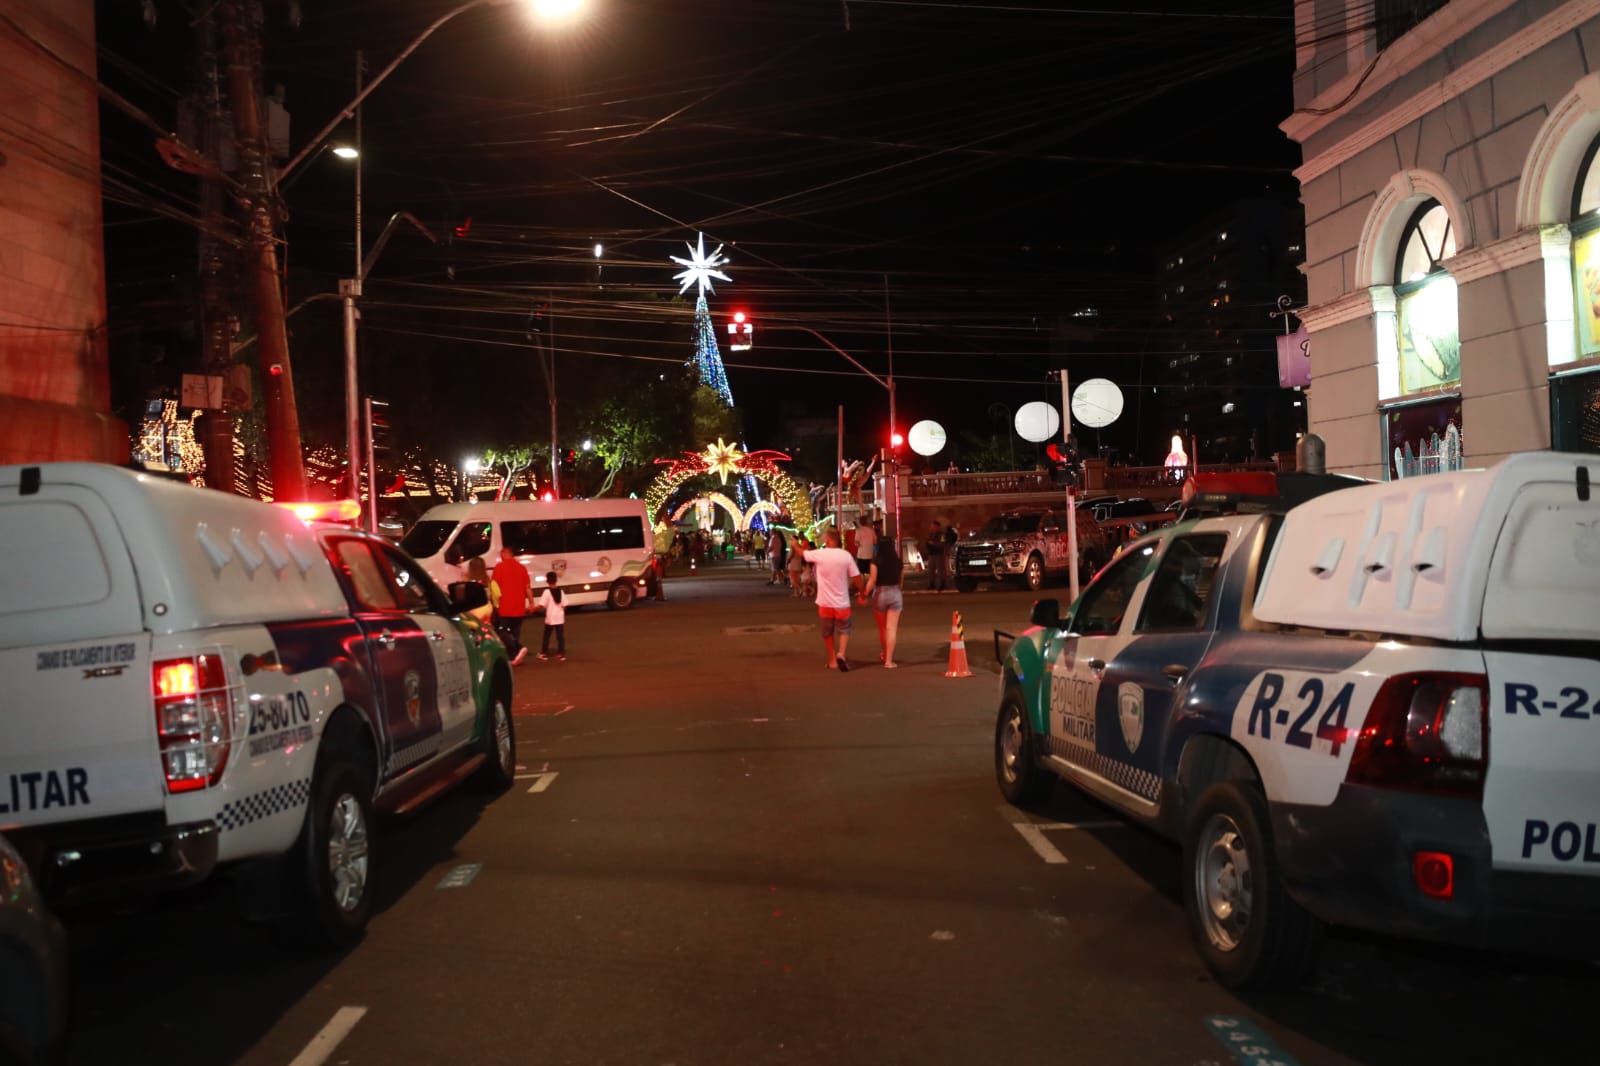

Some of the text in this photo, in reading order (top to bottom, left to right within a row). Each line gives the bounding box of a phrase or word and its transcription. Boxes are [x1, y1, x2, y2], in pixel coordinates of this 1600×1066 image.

[1063, 715, 1096, 744] MILITAR
[1247, 672, 1355, 758] R-24
[1521, 819, 1600, 863] POL
